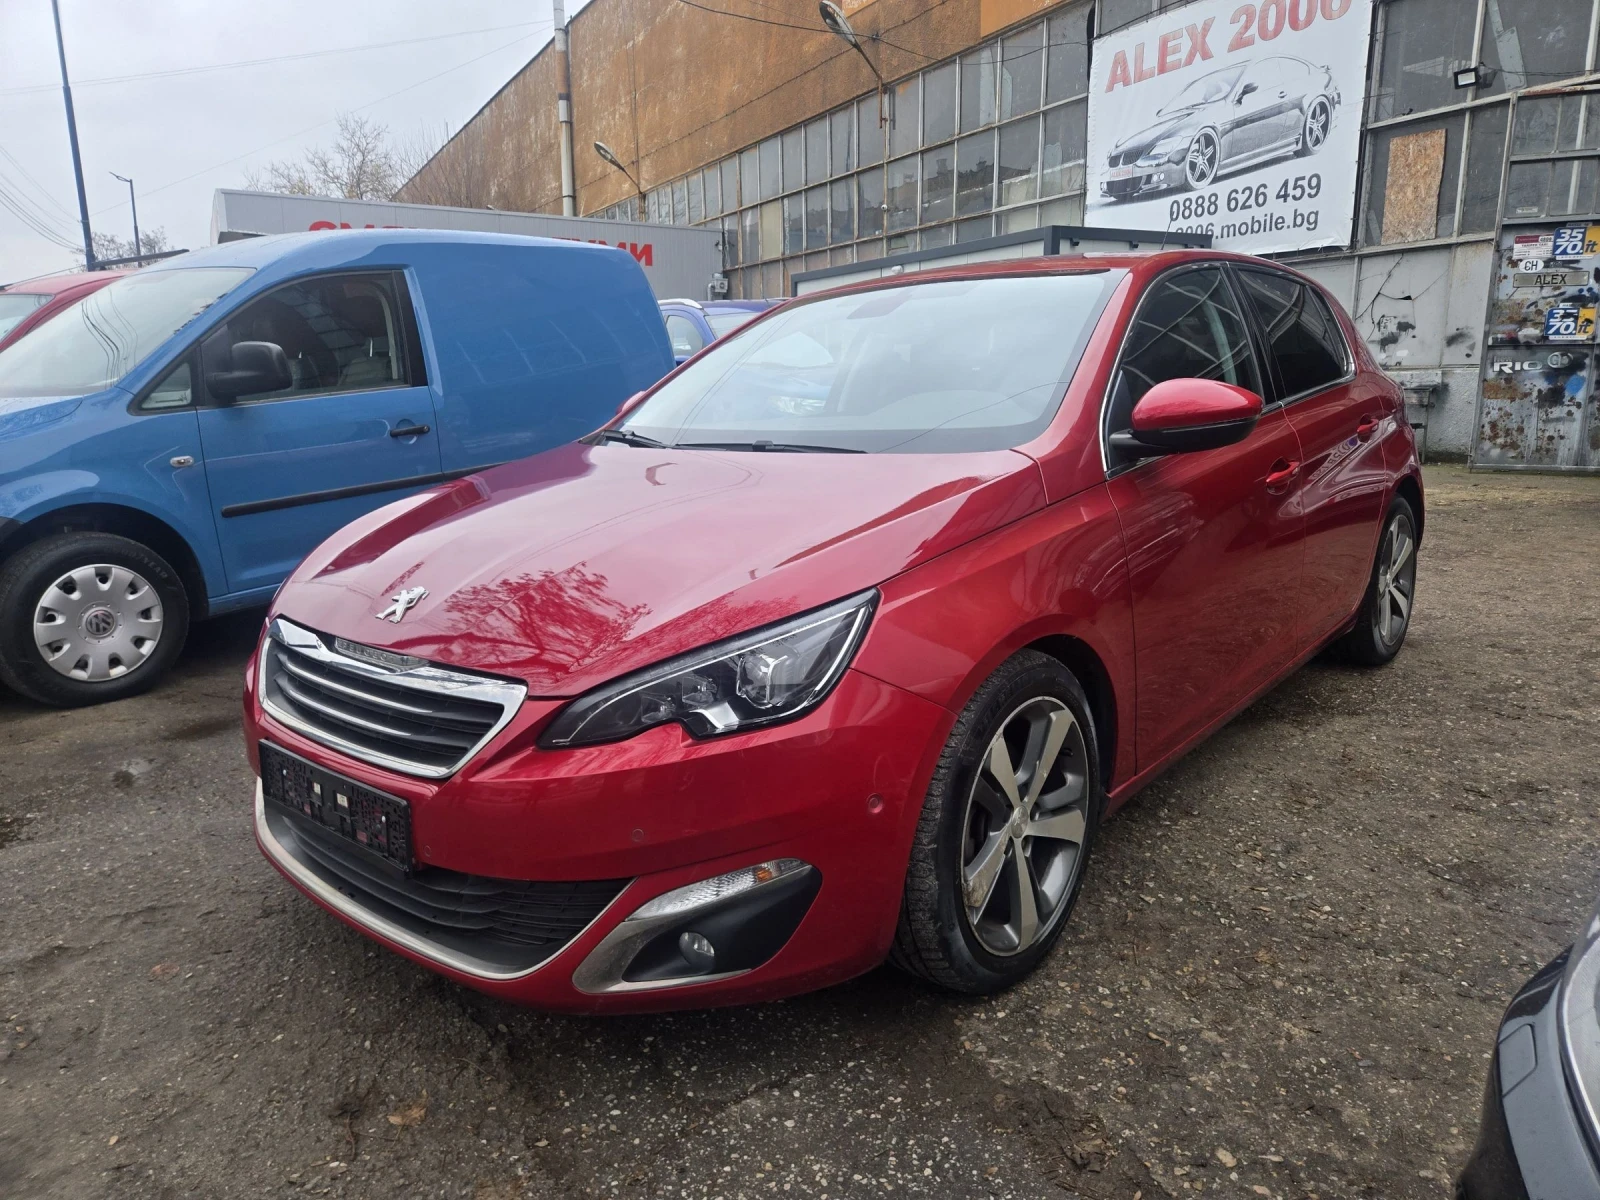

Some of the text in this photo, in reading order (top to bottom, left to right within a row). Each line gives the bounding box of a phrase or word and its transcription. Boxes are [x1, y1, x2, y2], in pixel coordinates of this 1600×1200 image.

[1105, 16, 1216, 93] ALEX
[1169, 172, 1322, 222] 0888 626 459
[1556, 228, 1585, 242] 35
[1534, 273, 1568, 285] ALEX
[1493, 361, 1542, 374] RIO
